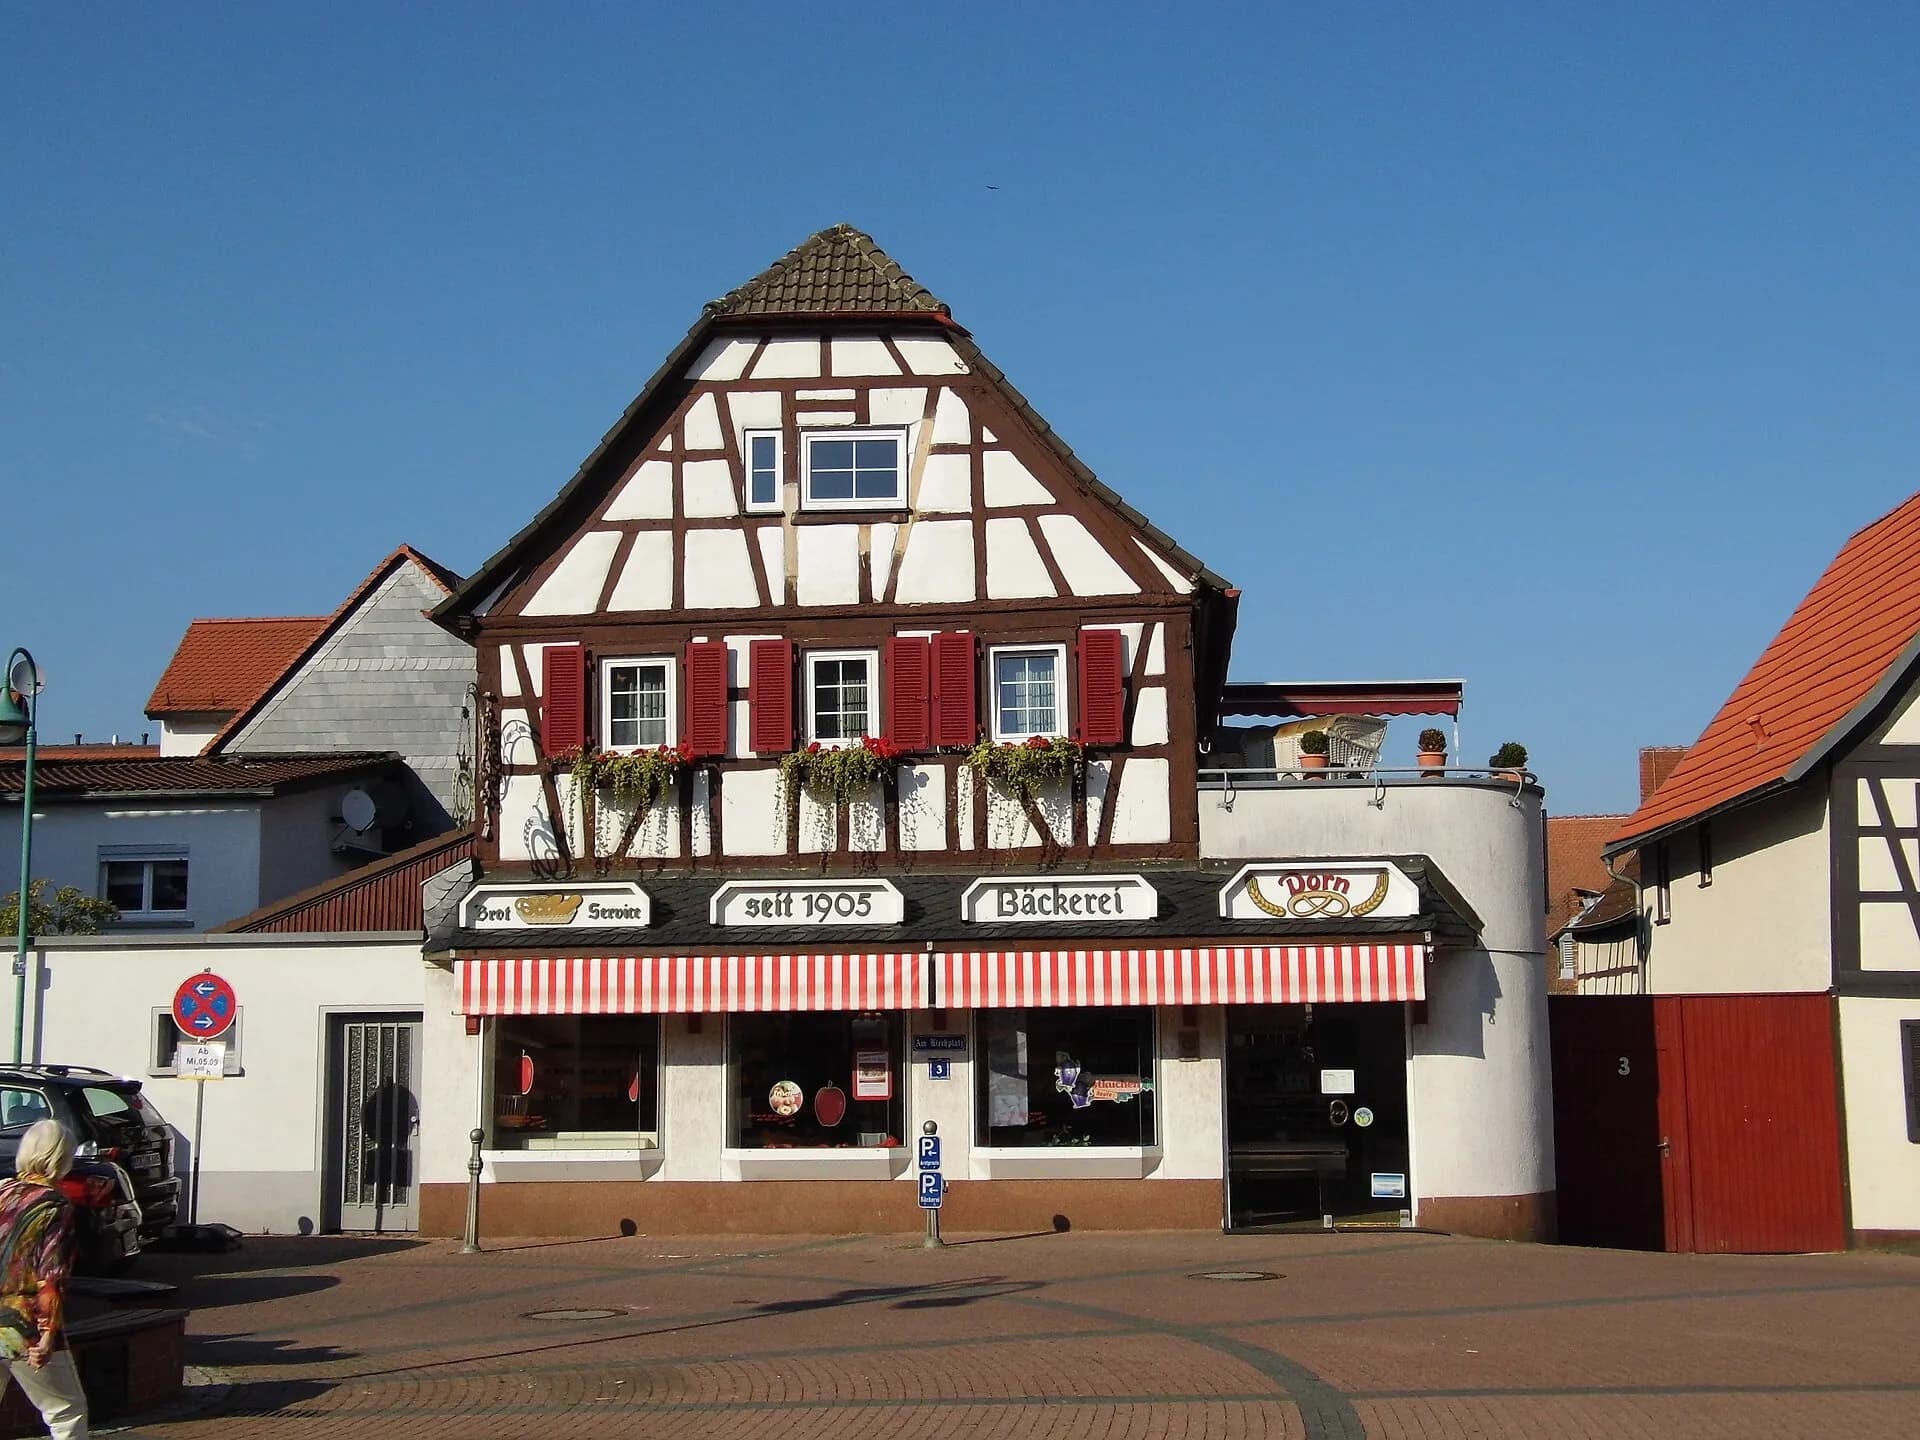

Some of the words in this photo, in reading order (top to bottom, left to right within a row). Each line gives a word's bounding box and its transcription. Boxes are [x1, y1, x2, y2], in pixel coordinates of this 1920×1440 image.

[1278, 872, 1350, 896] Dorn
[744, 889, 794, 918] seit
[802, 892, 872, 923] 1905
[997, 885, 1124, 917] Bäckerei
[475, 904, 512, 922] Brot
[588, 902, 642, 920] Service
[197, 1047, 209, 1055] Ab
[936, 1064, 943, 1074] 3
[1618, 1056, 1630, 1076] 3
[921, 1138, 934, 1157] P
[922, 1174, 936, 1194] P
